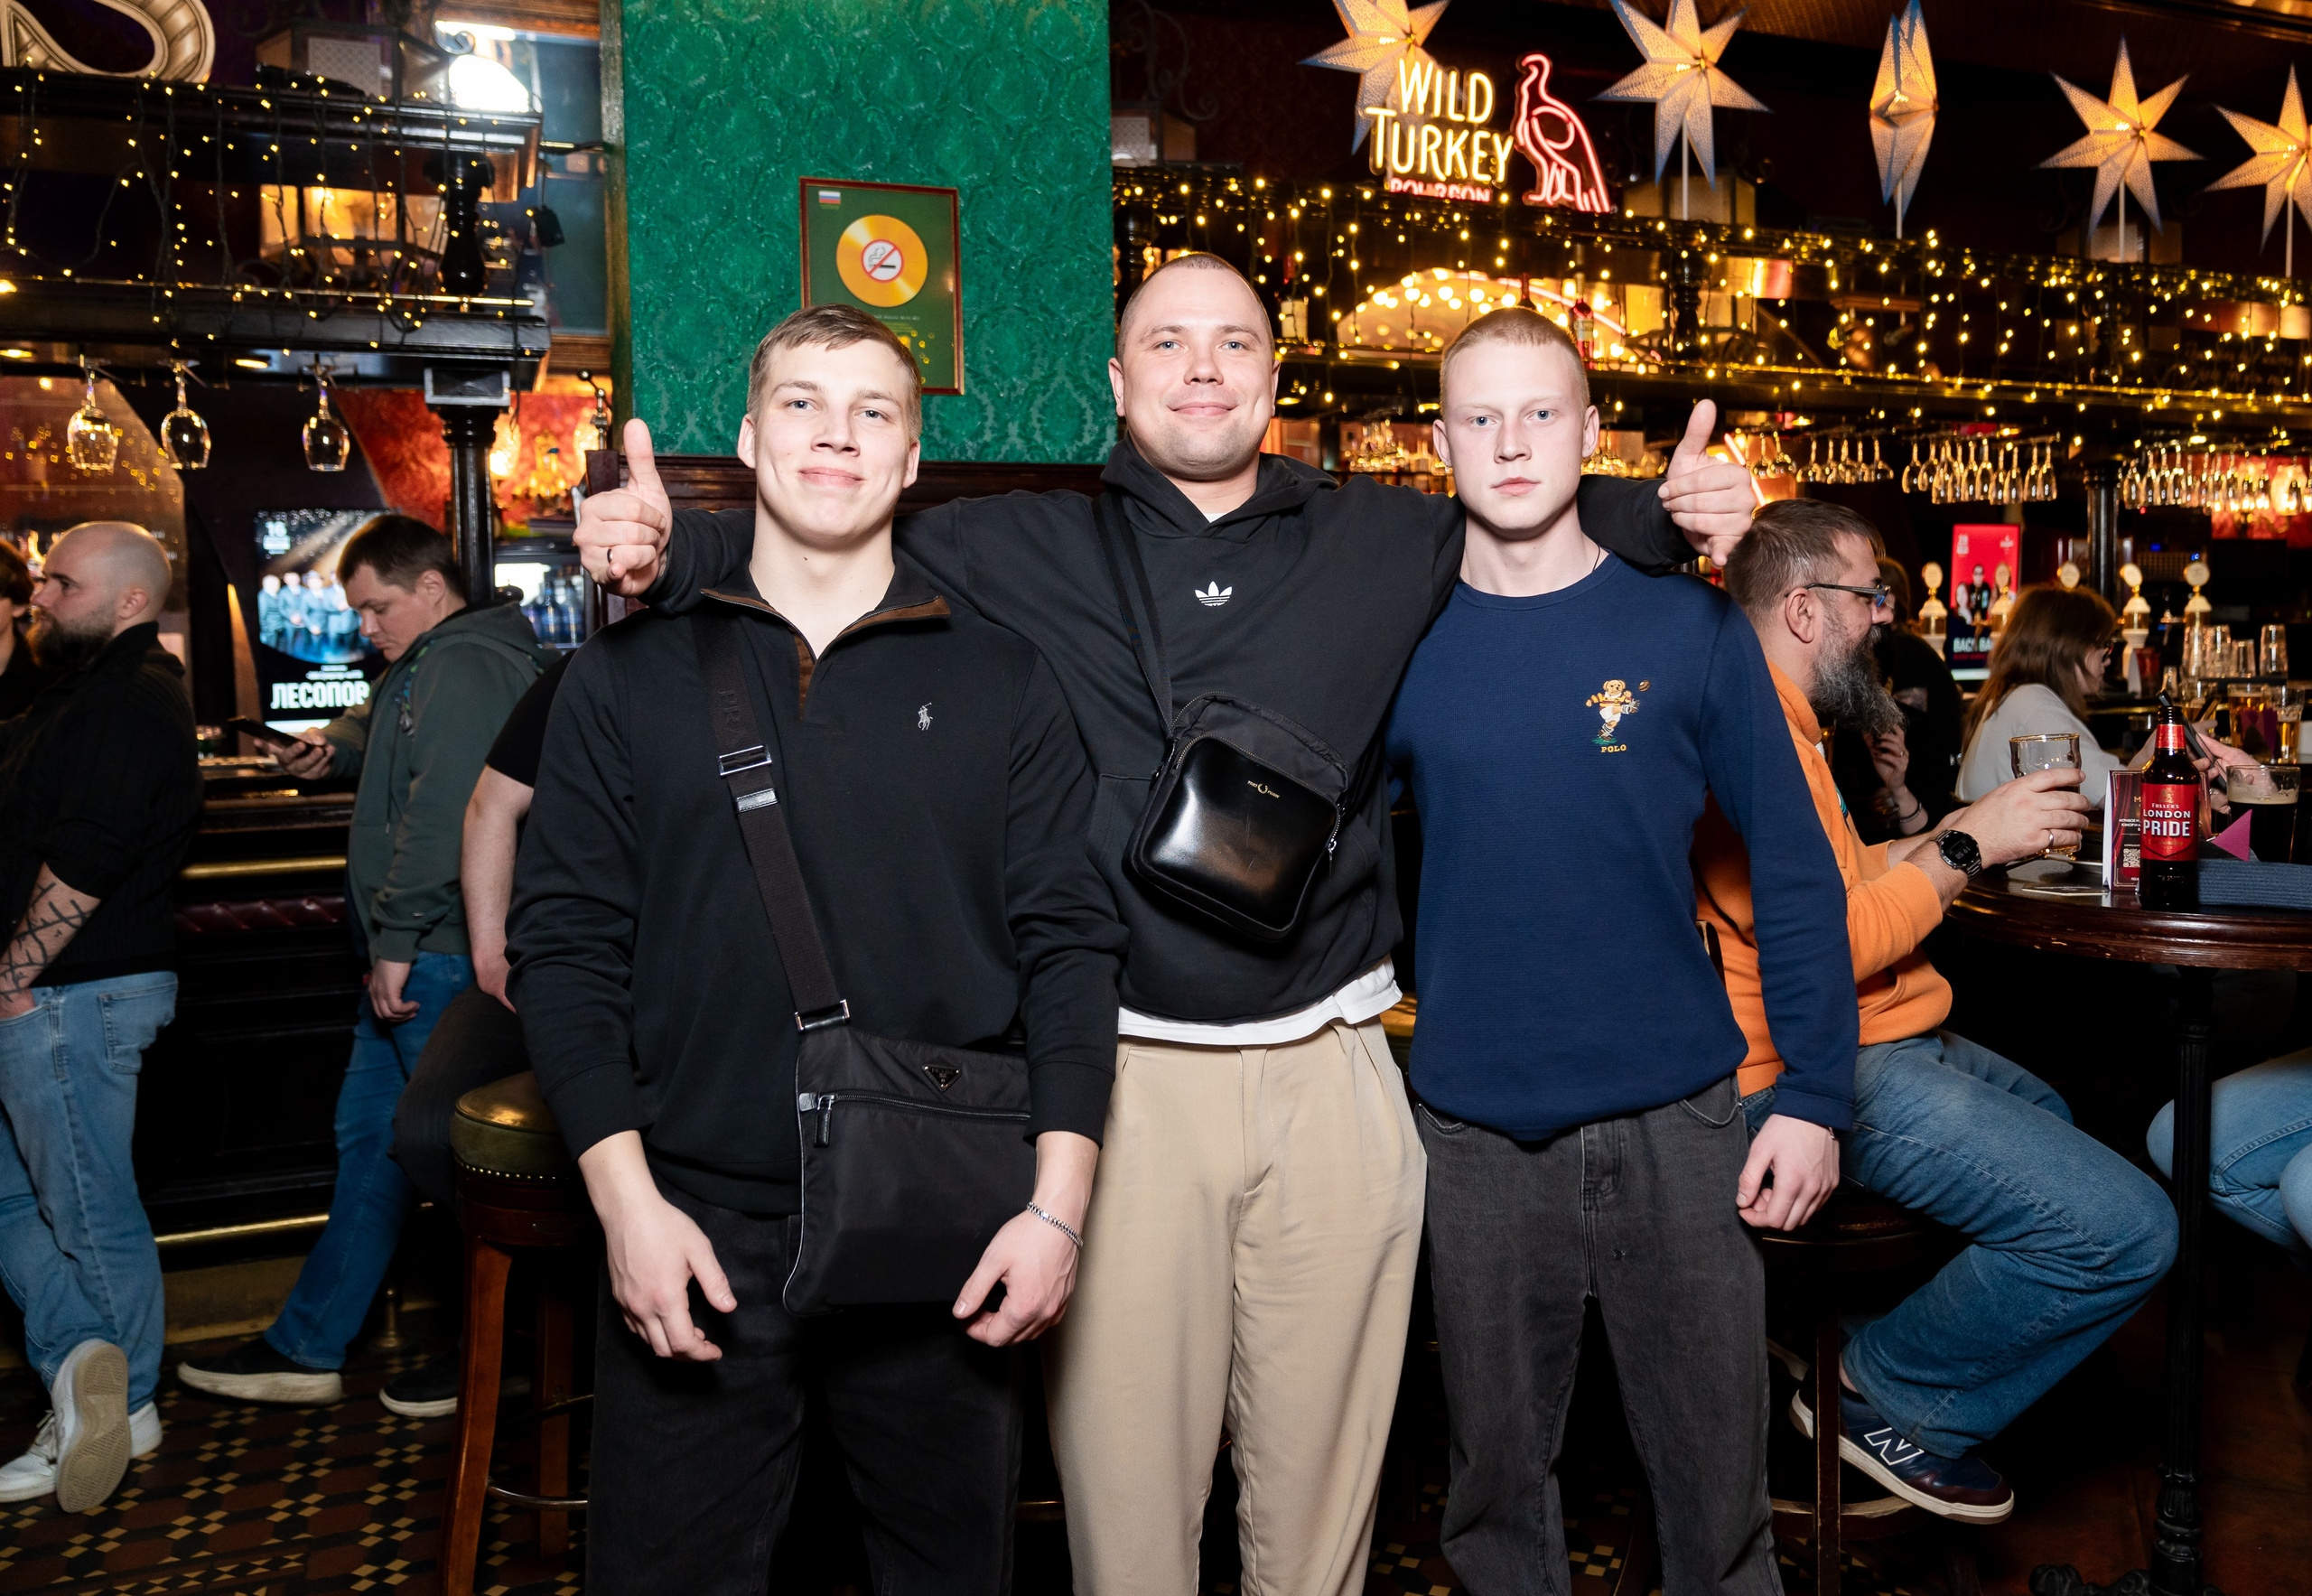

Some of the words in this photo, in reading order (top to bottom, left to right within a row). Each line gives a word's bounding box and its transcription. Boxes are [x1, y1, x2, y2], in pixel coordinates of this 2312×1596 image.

[1399, 58, 1493, 124] WILD
[1365, 107, 1515, 182] TURKEY
[1600, 744, 1627, 752] POLO
[2143, 808, 2191, 819] LONDON
[2143, 818, 2191, 837] PRIDE
